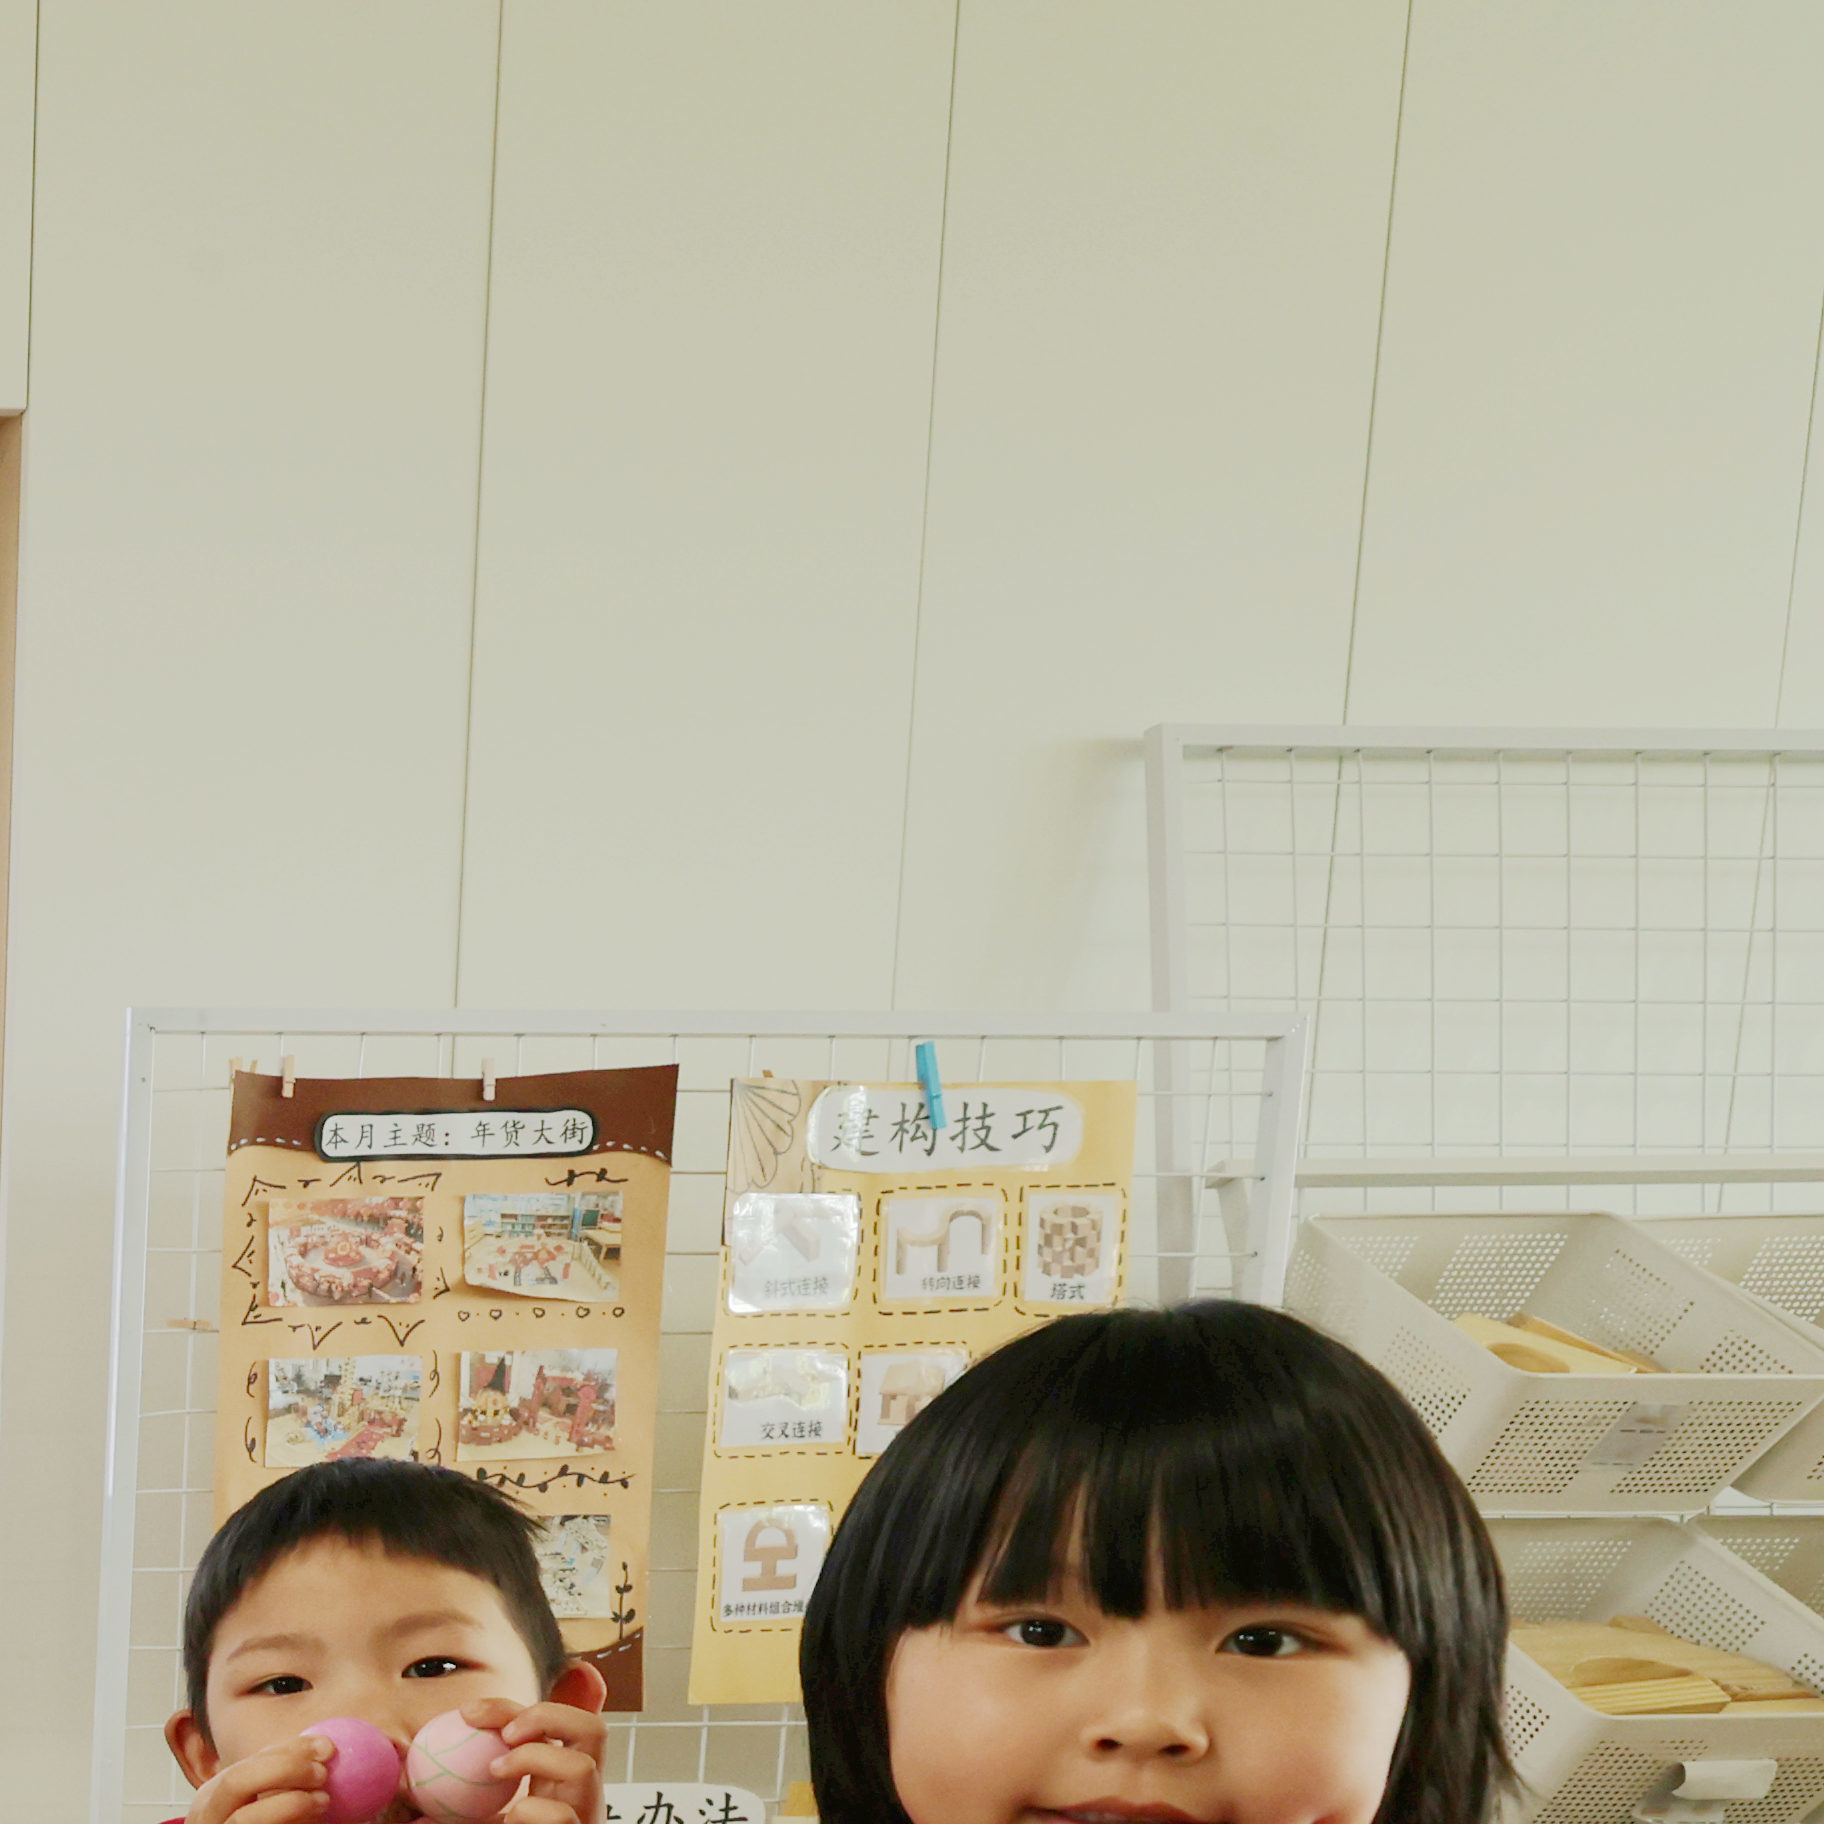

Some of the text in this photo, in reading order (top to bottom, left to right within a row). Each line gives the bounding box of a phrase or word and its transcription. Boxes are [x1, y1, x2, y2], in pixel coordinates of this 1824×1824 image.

[1051, 1282, 1086, 1300] 塔式
[761, 1420, 823, 1440] 交叉连接
